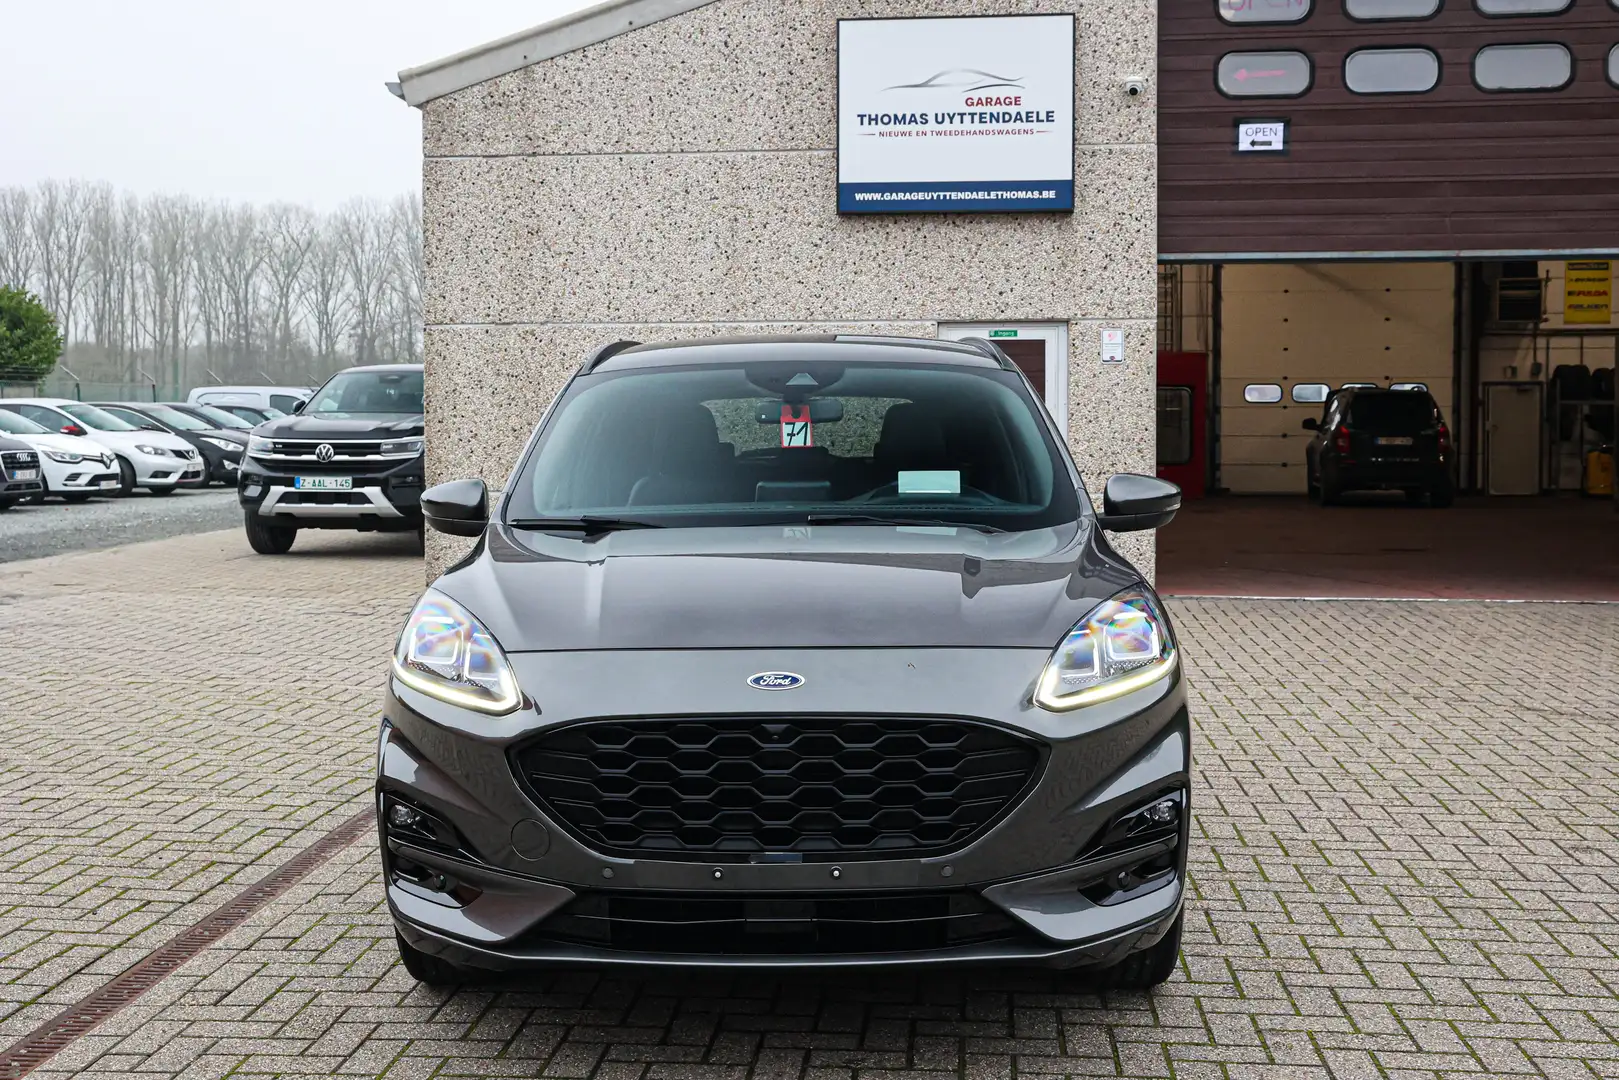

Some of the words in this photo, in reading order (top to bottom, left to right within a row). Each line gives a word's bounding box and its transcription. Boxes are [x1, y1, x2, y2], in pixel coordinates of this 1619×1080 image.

[965, 96, 1022, 107] GARAGE
[857, 113, 929, 126] THOMAS
[934, 110, 1055, 125] UYTTENDAELE
[878, 130, 913, 138] NIEUWE
[930, 128, 1035, 137] TWEEDEHANDSWAGENS
[1245, 127, 1278, 137] OPEN
[855, 190, 1056, 201] WWW.GARAGEUYTTENDAELETHOMAS.BE
[784, 421, 809, 446] 71
[760, 674, 792, 685] Ford
